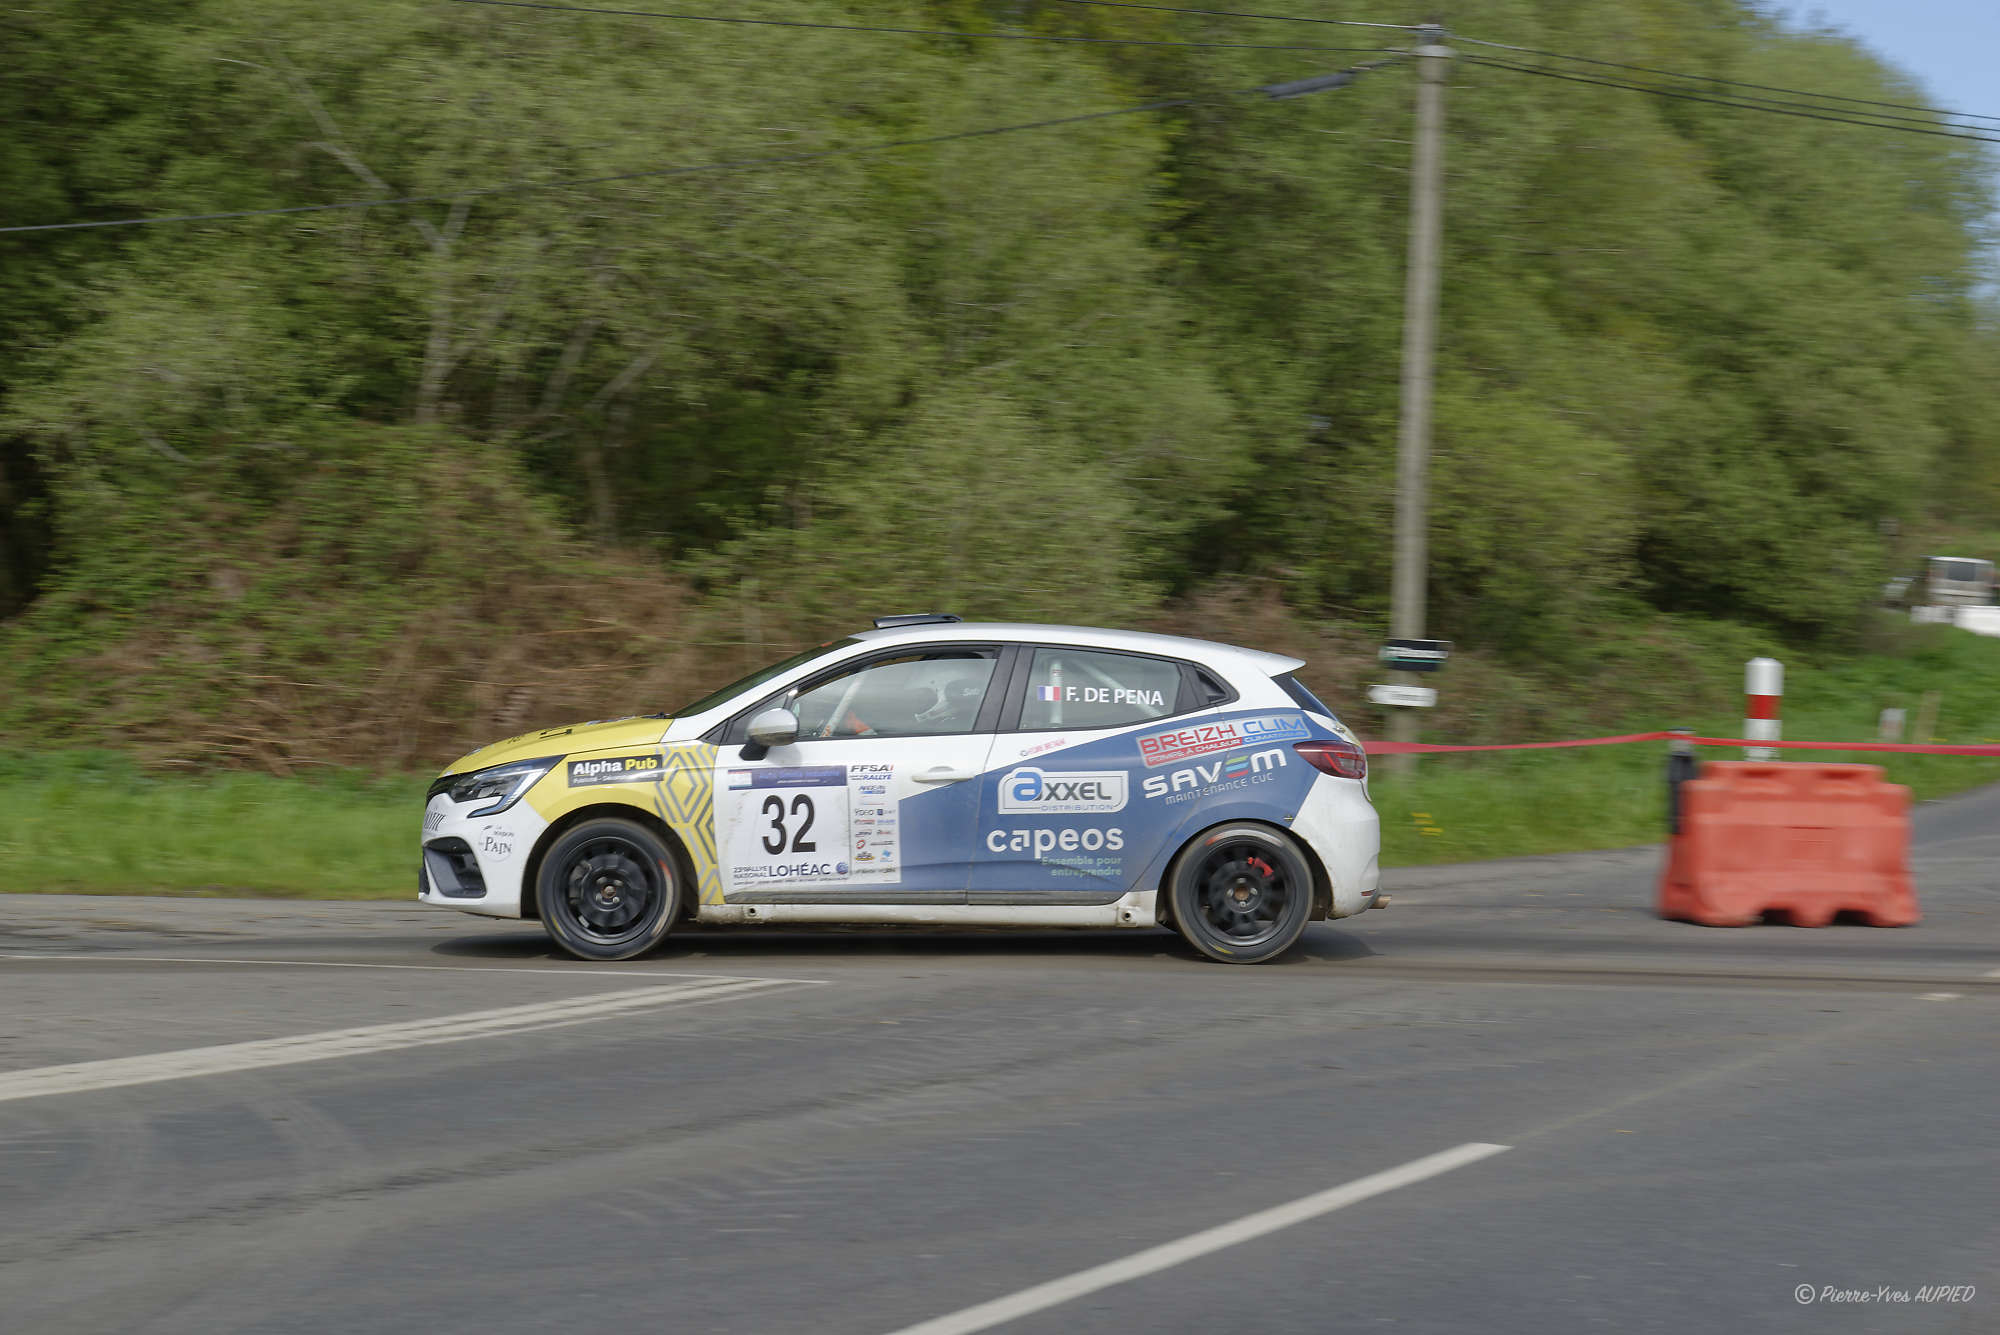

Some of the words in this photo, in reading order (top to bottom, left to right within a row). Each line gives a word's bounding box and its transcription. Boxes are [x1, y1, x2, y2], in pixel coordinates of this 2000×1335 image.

[1066, 686, 1080, 702] F.
[1084, 687, 1110, 703] DE
[1113, 689, 1165, 706] PENA
[1139, 724, 1237, 755] BREIZH
[1243, 716, 1305, 734] CLIM
[1195, 739, 1241, 753] CHALEUR
[573, 760, 623, 776] Alpha
[625, 757, 658, 771] Pub
[850, 764, 889, 772] FFSA
[1165, 777, 1249, 806] MAINTENANCE
[1040, 804, 1114, 812] DISTRIBUTION
[762, 793, 816, 855] 32
[484, 836, 512, 855] PAIN
[986, 827, 1124, 860] capeos
[769, 862, 831, 877] LOHÉAC
[1041, 855, 1094, 865] Ensemble
[1096, 857, 1122, 867] pour
[1051, 866, 1122, 878] entreprendre
